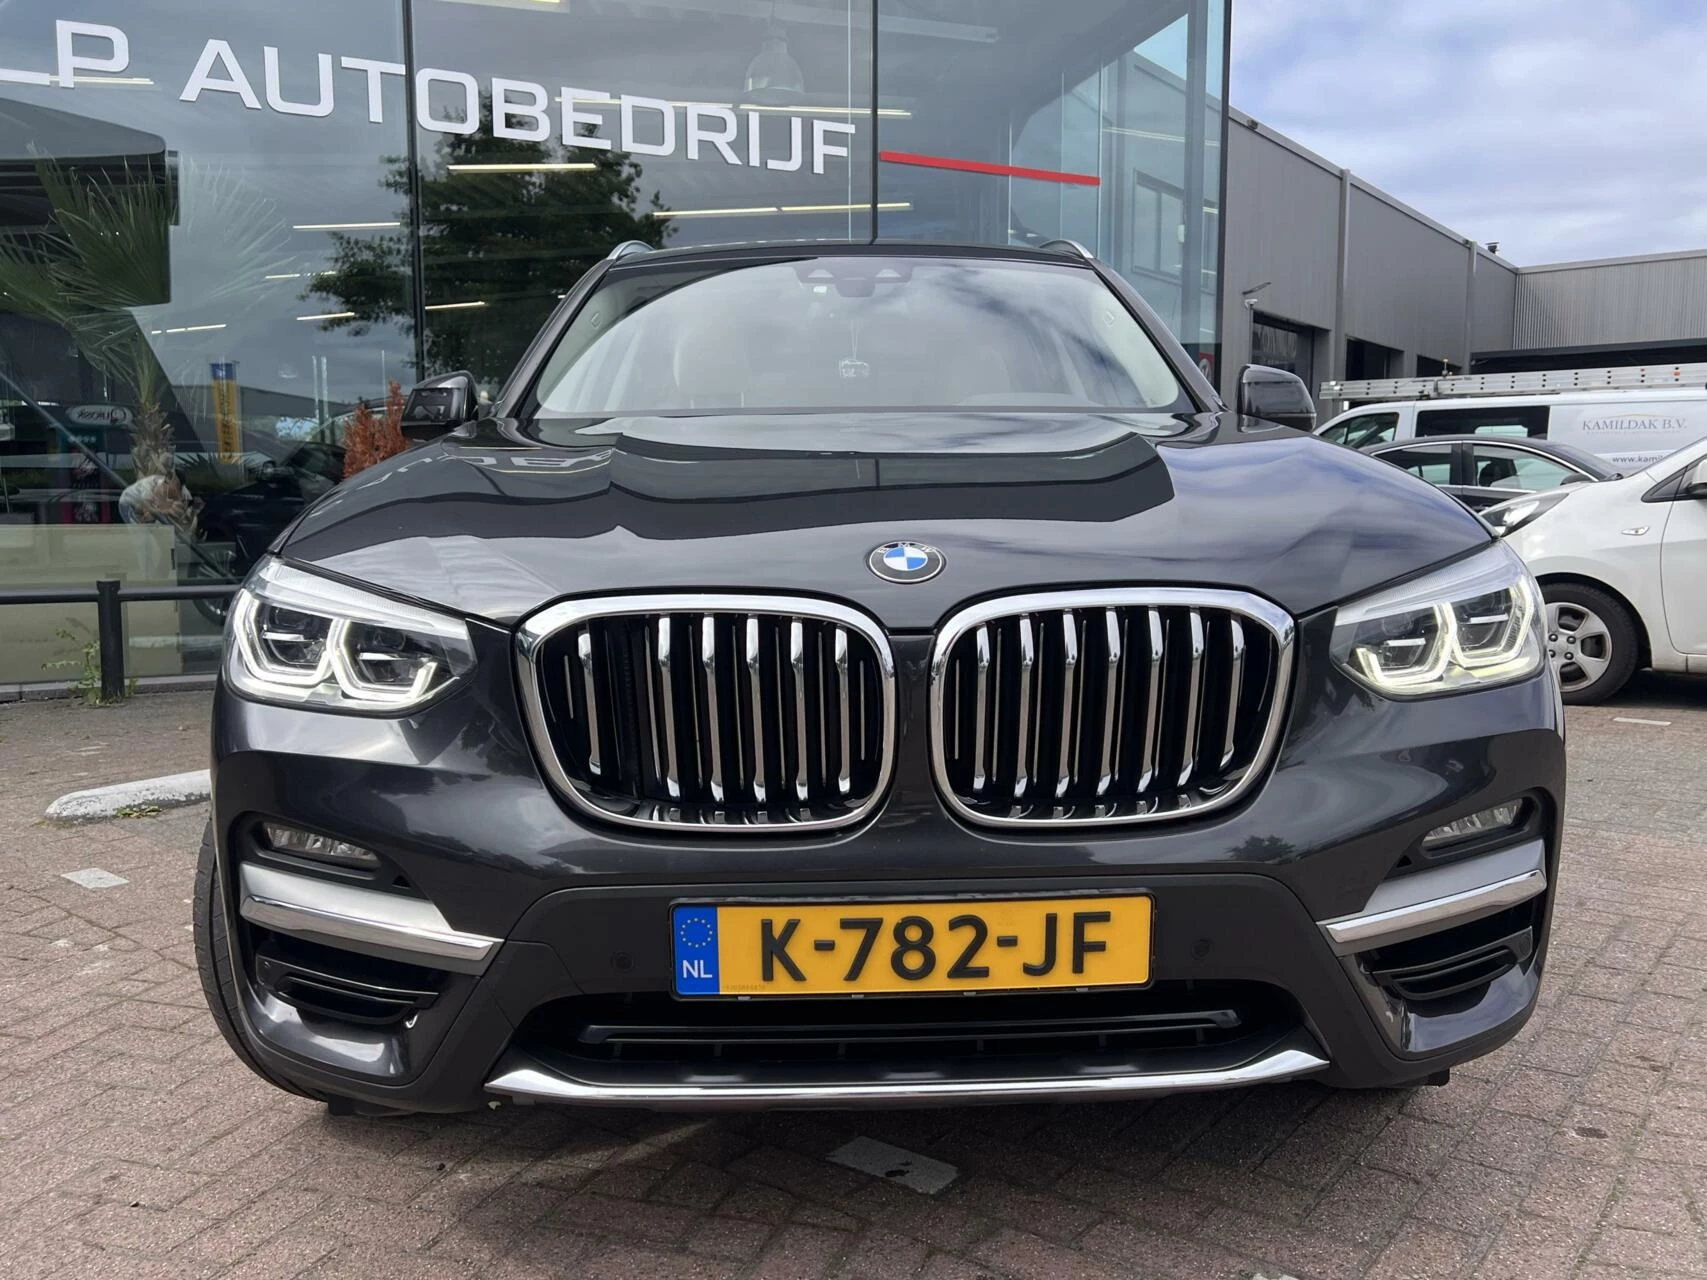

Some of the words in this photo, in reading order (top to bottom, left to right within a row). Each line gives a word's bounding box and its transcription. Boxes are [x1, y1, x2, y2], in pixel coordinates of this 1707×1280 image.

[179, 38, 856, 174] AUTOBEDRIJF
[1582, 419, 1657, 431] KAMILDAK
[1662, 419, 1687, 430] B.V.
[760, 911, 1111, 982] K-782-JF
[682, 960, 712, 979] NL
